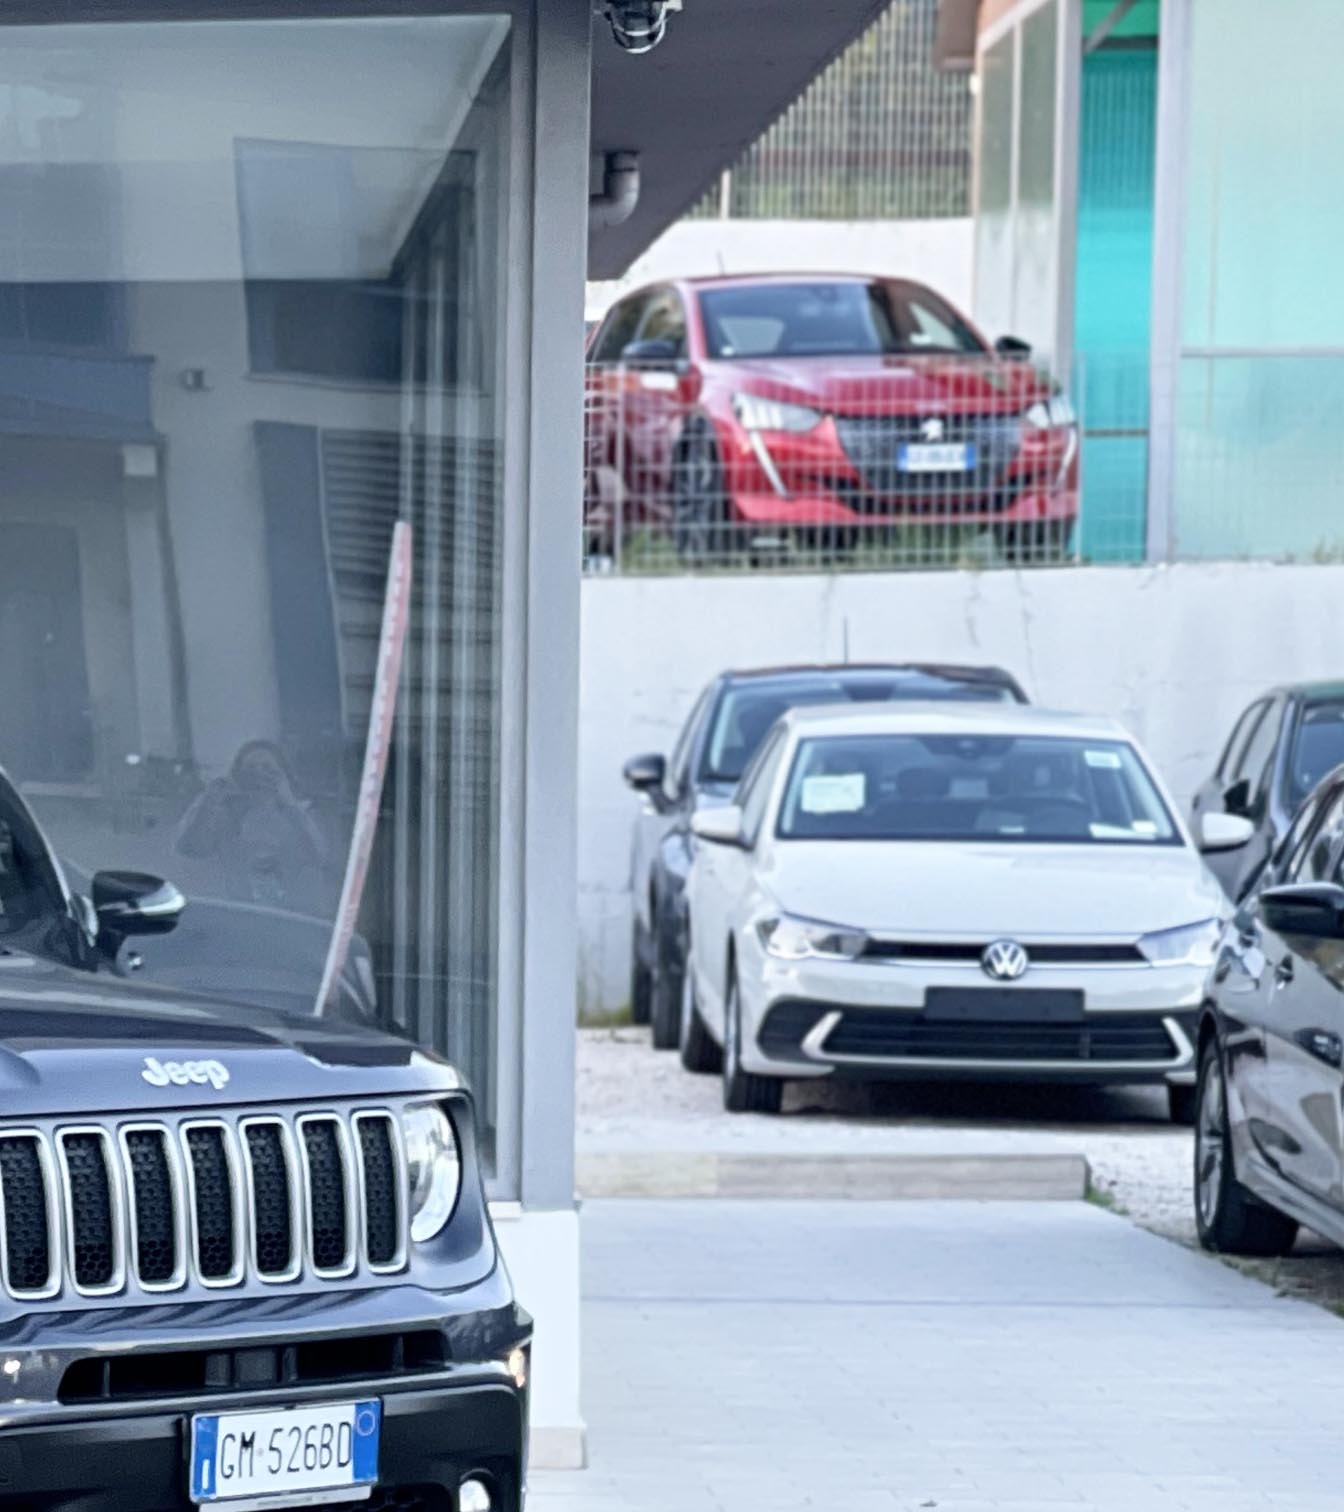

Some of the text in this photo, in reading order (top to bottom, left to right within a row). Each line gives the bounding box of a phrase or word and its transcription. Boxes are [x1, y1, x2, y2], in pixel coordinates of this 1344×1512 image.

[141, 1057, 230, 1090] Jeep
[220, 1421, 353, 1479] GM 526BD
